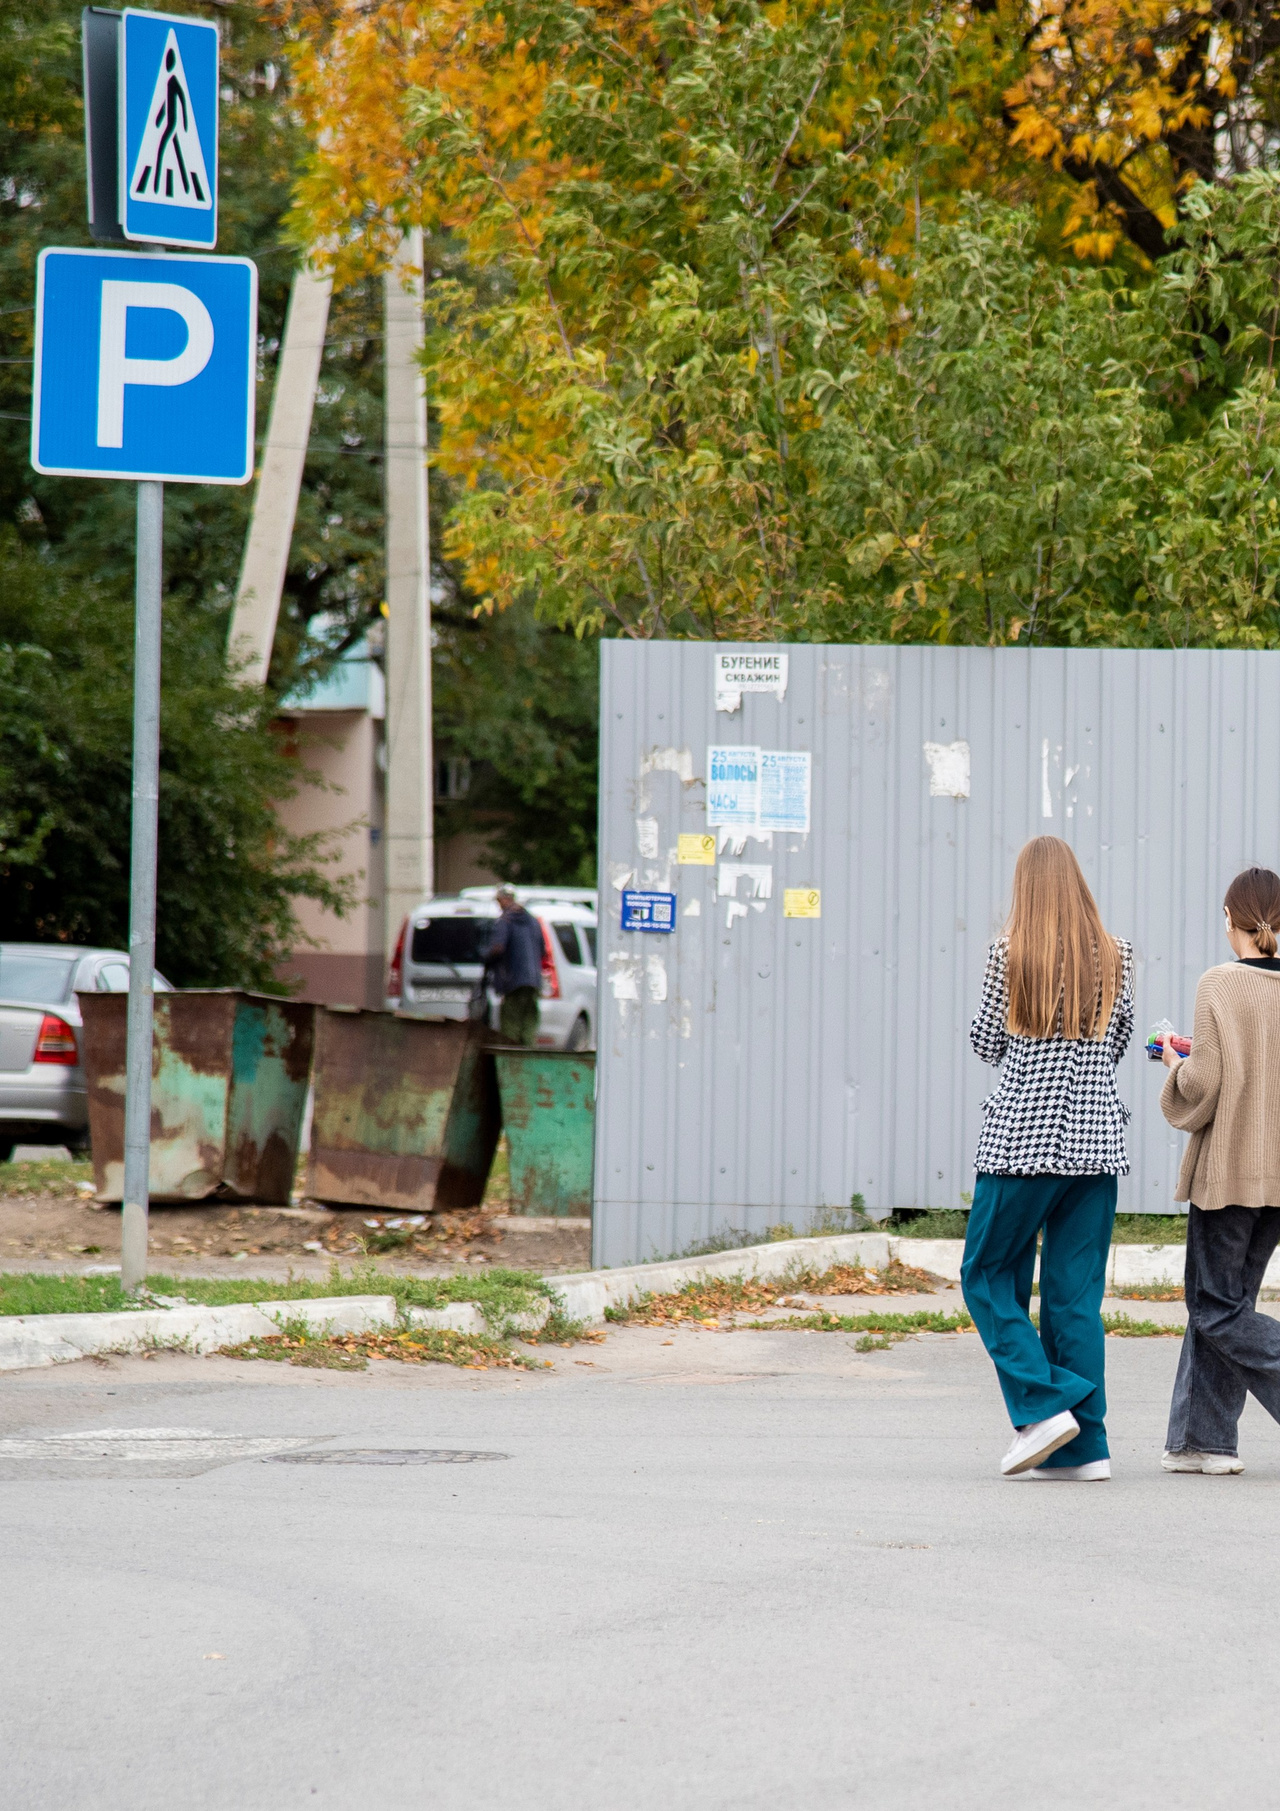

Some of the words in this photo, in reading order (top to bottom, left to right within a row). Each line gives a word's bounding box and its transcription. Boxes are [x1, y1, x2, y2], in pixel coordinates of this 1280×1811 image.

[97, 280, 215, 449] P
[721, 656, 780, 669] БУРЕНИЕ
[725, 673, 780, 682] СКВАЖИН
[712, 751, 727, 763] 25
[762, 755, 776, 767] 25
[711, 764, 757, 781] ВОЛОСЫ
[710, 794, 738, 809] ЧАСЫ
